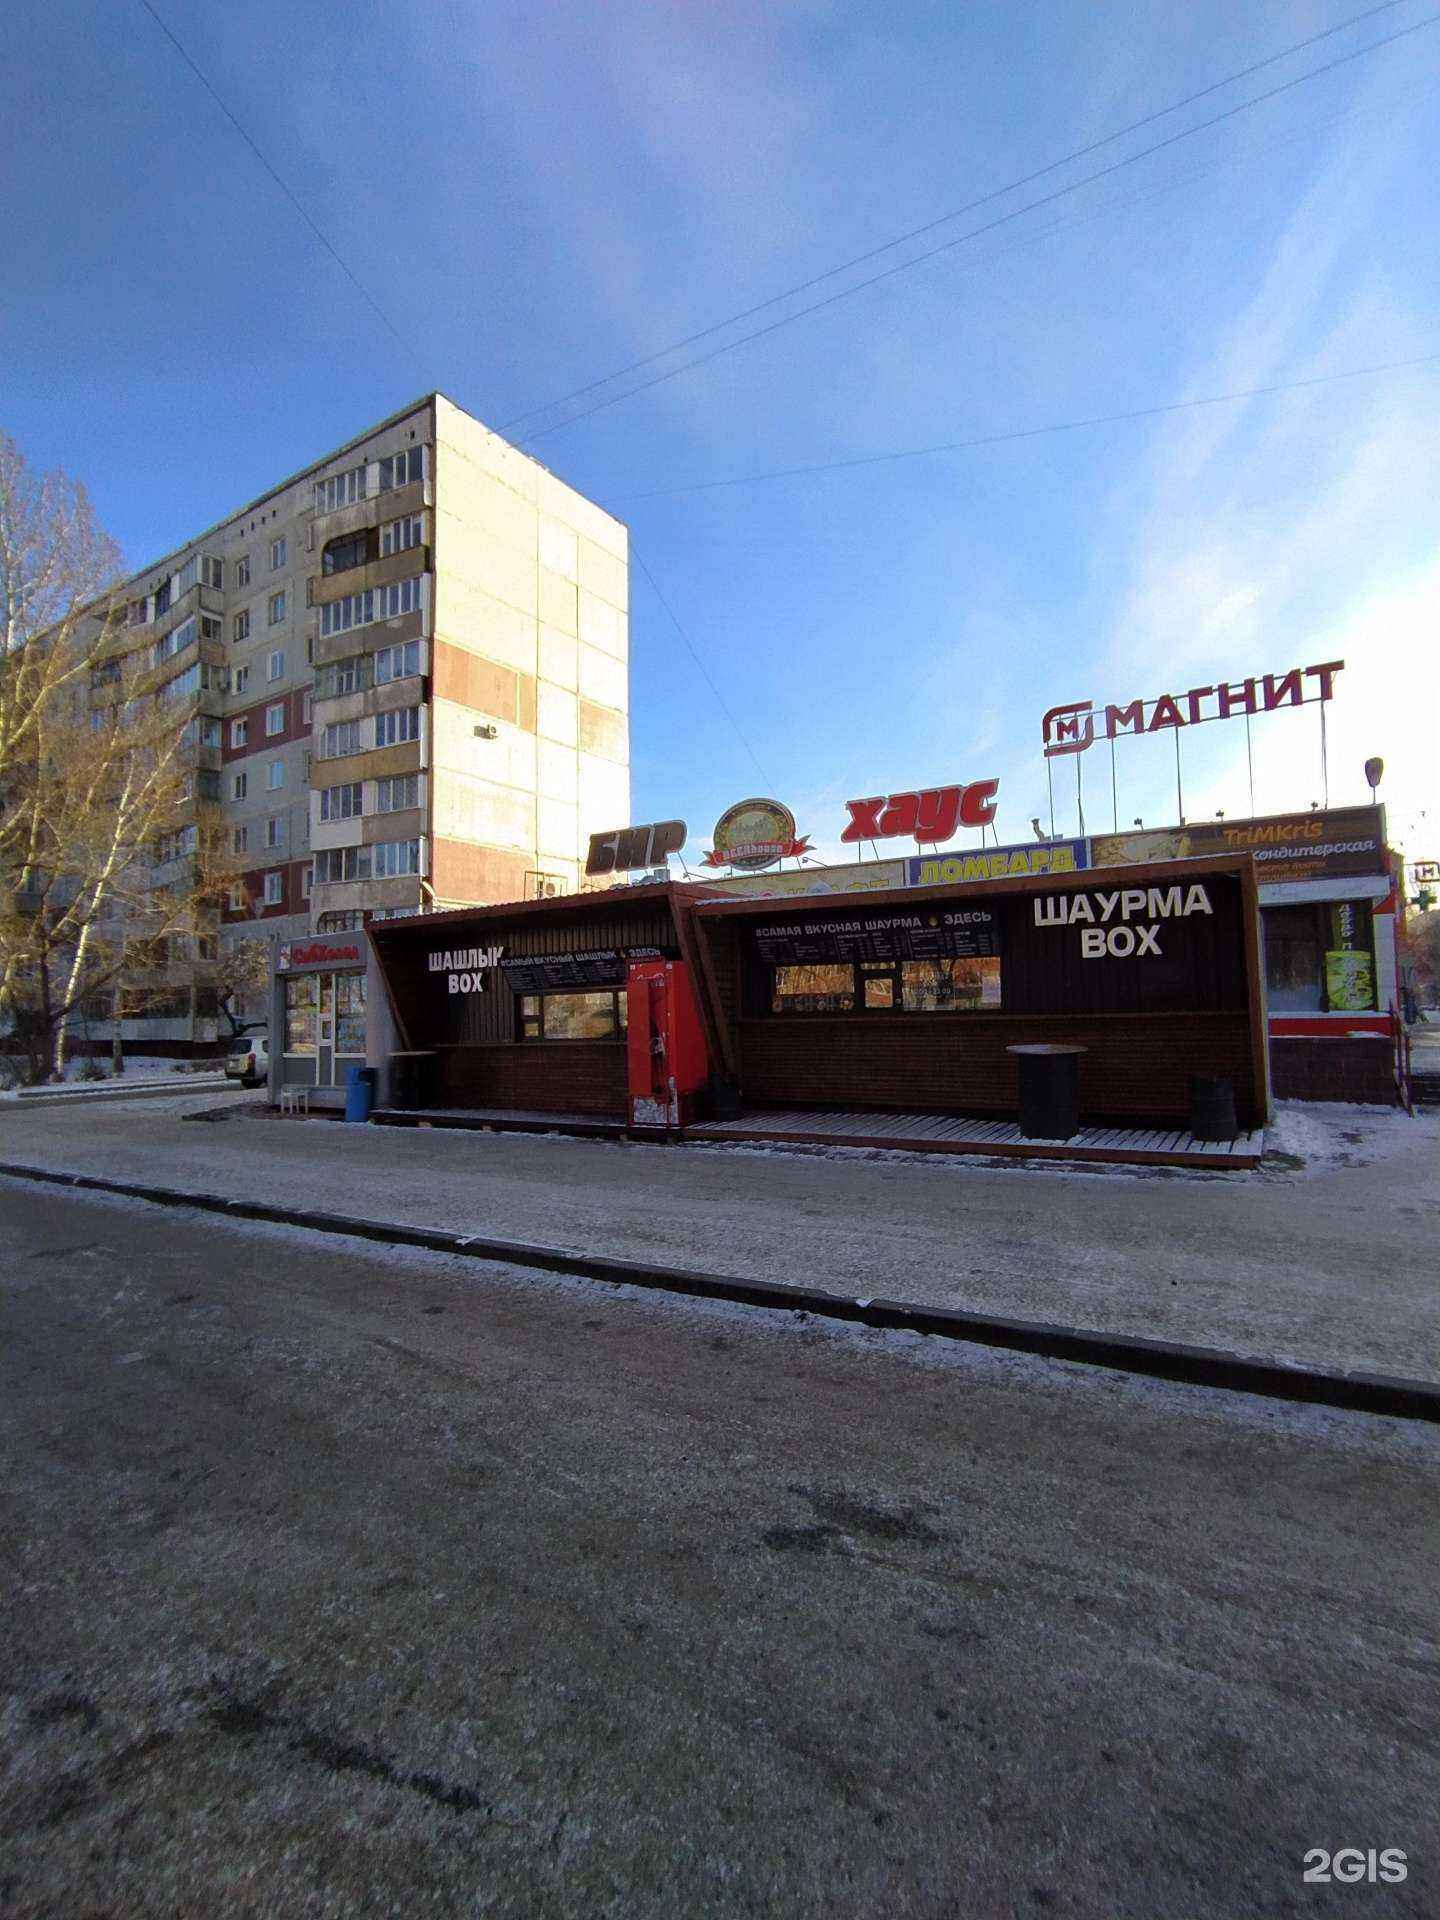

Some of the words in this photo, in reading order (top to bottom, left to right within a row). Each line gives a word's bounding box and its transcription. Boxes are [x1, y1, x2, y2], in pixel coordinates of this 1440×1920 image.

[1106, 660, 1345, 738] МАГНИТ
[918, 846, 1077, 885] ЛОМБАРД
[1033, 884, 1213, 927] ШАУРМА
[756, 925, 802, 938] #САМАЯ
[805, 921, 862, 935] ВКУСНАЯ
[865, 916, 922, 931] ШАУРМА
[944, 911, 992, 926] ЗДЕСЬ
[428, 946, 505, 972] ШАШЛЫК
[534, 953, 574, 965] ВКУСНЫЙ
[575, 949, 617, 961] ШАШЛЫК
[628, 947, 661, 958] ЗДЕСЬ
